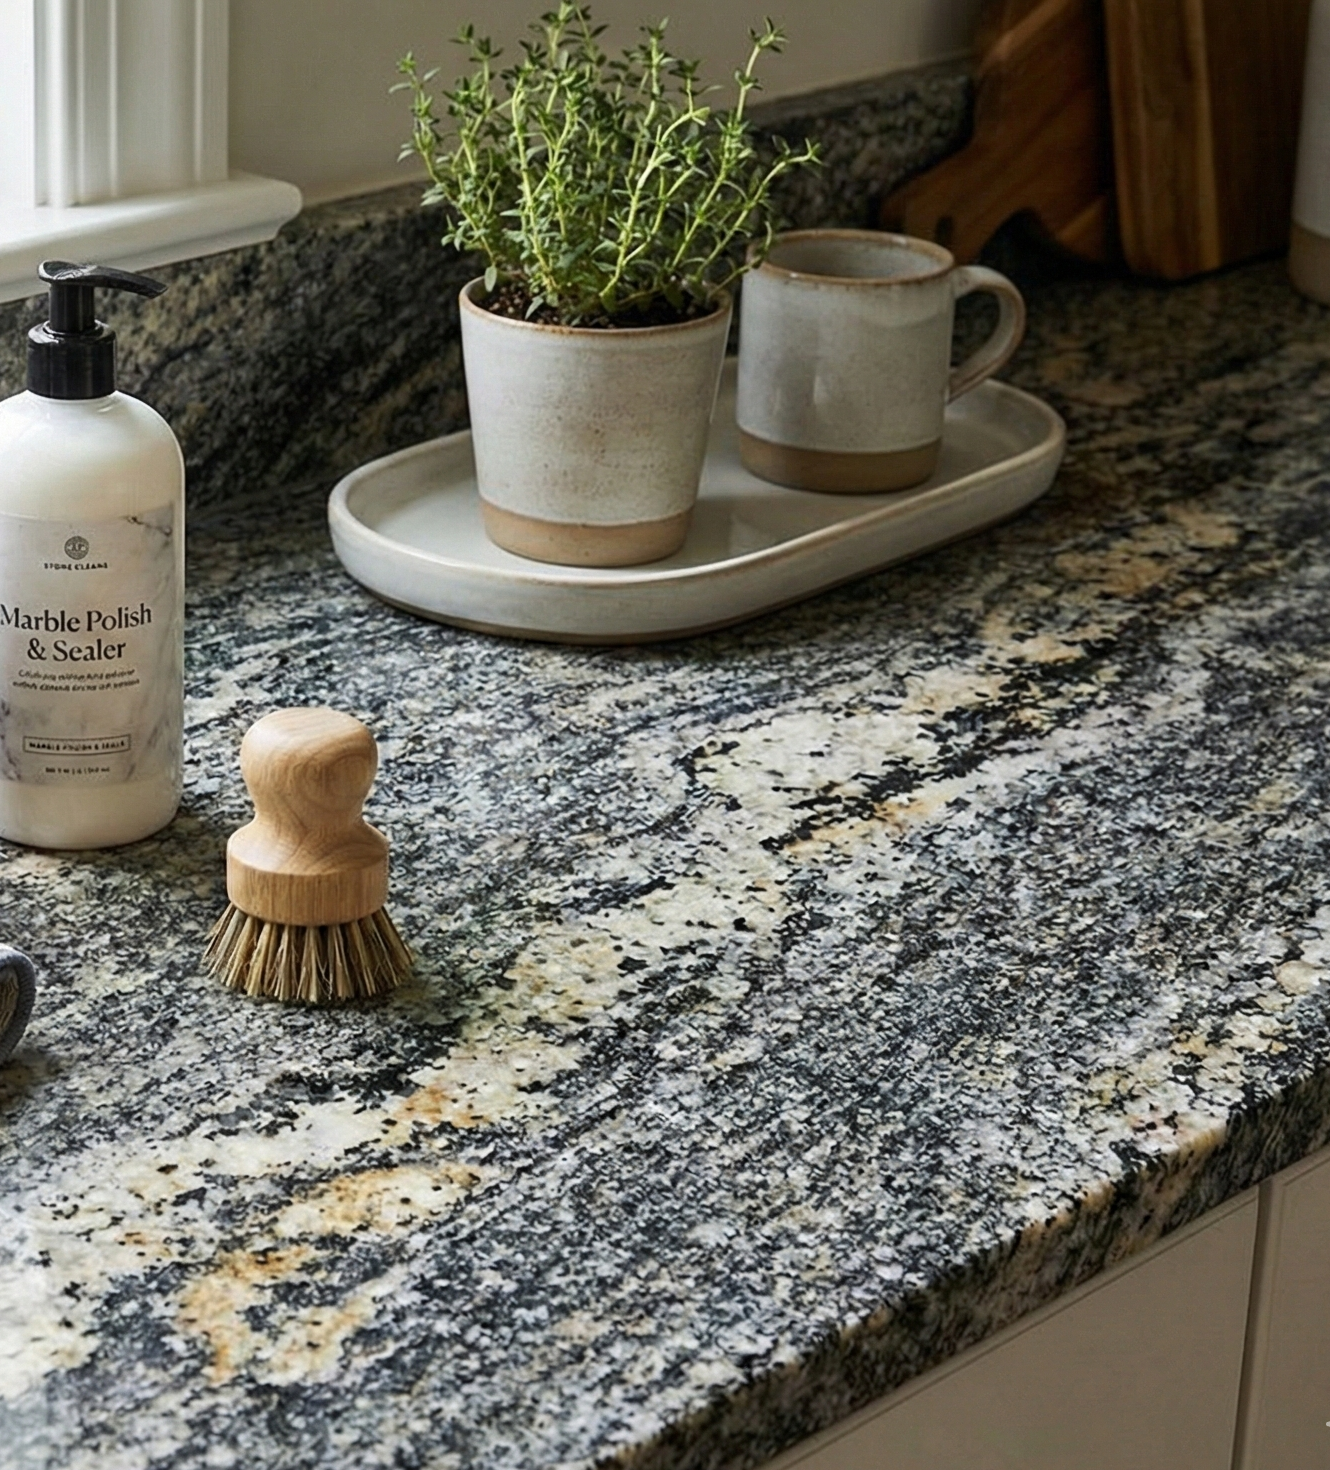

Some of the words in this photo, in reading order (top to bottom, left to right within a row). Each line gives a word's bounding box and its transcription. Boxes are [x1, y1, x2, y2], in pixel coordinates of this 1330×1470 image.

[0, 604, 81, 632] Marble
[86, 603, 152, 632] Polish
[27, 637, 47, 661] &
[52, 638, 126, 662] Sealer
